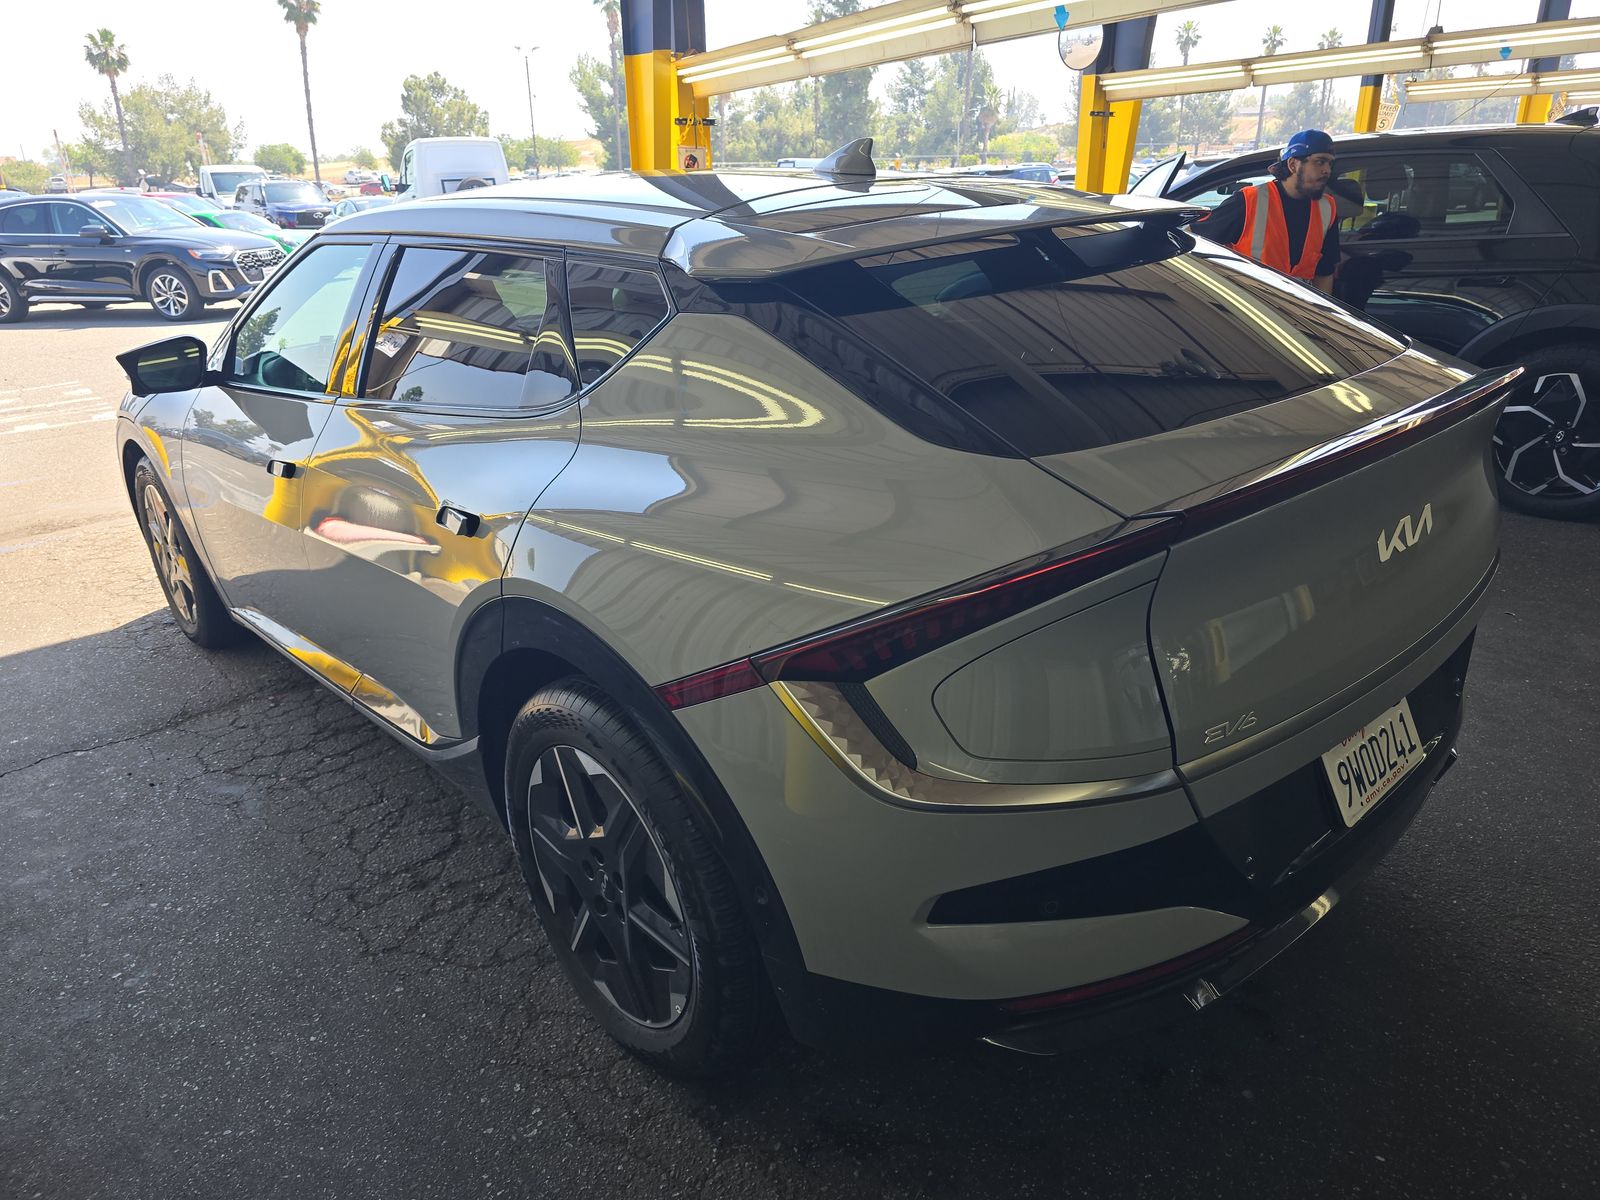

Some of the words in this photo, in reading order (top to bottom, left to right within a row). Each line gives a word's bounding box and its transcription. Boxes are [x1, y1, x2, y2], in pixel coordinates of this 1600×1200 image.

[1378, 118, 1387, 129] 5
[1377, 503, 1433, 562] KIA
[1204, 711, 1257, 743] EV6
[1365, 763, 1406, 804] dmv.ca.gov
